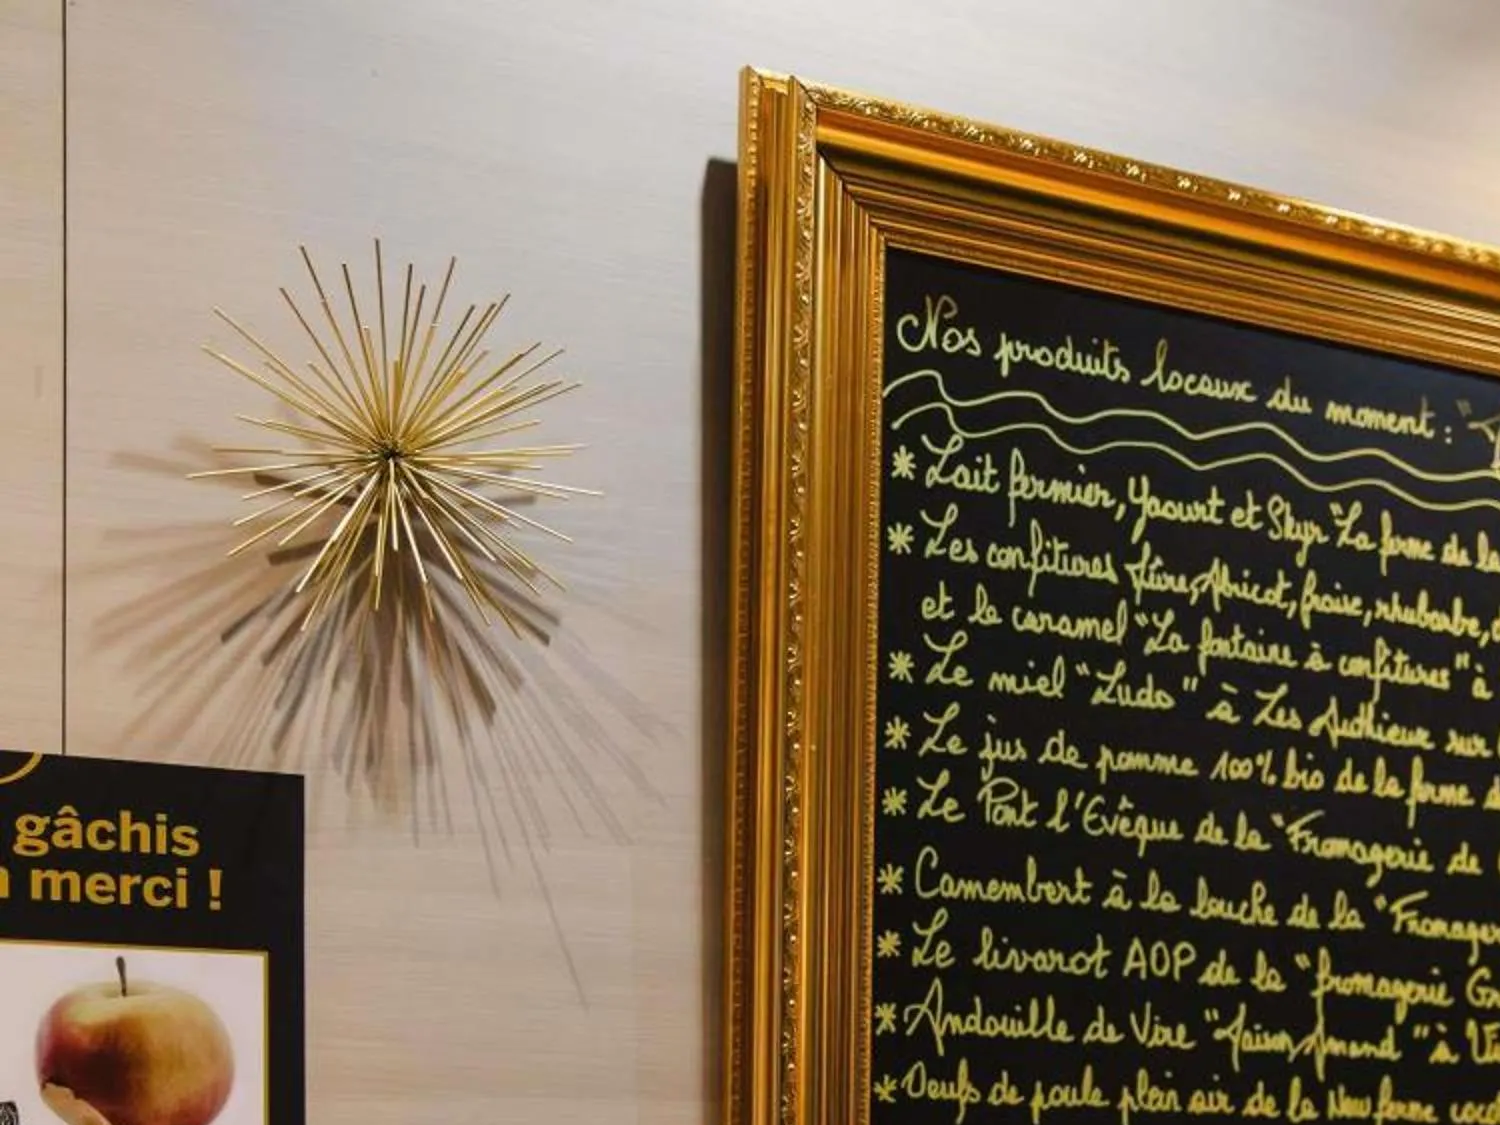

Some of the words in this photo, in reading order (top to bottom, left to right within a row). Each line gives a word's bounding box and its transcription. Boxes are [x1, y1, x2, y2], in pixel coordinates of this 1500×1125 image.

[897, 295, 981, 356] Nos
[994, 332, 1131, 384] produits
[1141, 338, 1257, 402] locaux
[1267, 374, 1312, 414] du
[925, 434, 1000, 488] Lait
[1230, 490, 1264, 531] et
[1266, 495, 1330, 567] Skyr
[1440, 533, 1473, 568] de
[920, 503, 979, 562] Les
[985, 518, 1120, 598] confitures
[920, 580, 956, 620] et
[1012, 598, 1130, 645] caramel
[1304, 642, 1332, 672] à
[1472, 664, 1494, 700] à
[923, 630, 974, 684] Le
[988, 656, 1065, 699] miel
[1205, 682, 1241, 724] à
[1253, 683, 1302, 730] Les
[918, 701, 968, 757] Le
[977, 713, 1027, 782] jus
[1038, 728, 1088, 768] de
[1097, 743, 1200, 784] pomme
[1282, 746, 1325, 790] bio
[1334, 756, 1368, 793] de
[1371, 755, 1405, 798] la
[13, 805, 201, 857] gâchis
[916, 768, 967, 820] Le
[977, 776, 1040, 828] Pont
[1194, 811, 1229, 844] de
[1234, 809, 1273, 850] la
[1446, 840, 1484, 875] de
[30, 867, 189, 909] merci
[914, 845, 1094, 905] Camembert
[1102, 869, 1132, 911] à
[1139, 868, 1182, 913] la
[1188, 875, 1280, 928] louche
[1286, 893, 1320, 930] de
[1328, 889, 1366, 930] la
[912, 907, 956, 968] Le
[972, 925, 1111, 979] livarot
[1122, 936, 1197, 981] AOP
[1198, 950, 1241, 985] de
[1250, 949, 1288, 992] la
[903, 977, 1075, 1056] Andouille
[1082, 1004, 1125, 1043] de
[1129, 1001, 1197, 1048] Vire
[1428, 1022, 1460, 1064] à
[987, 1069, 1025, 1105] de
[1187, 1073, 1235, 1114] air
[1241, 1079, 1281, 1118] de
